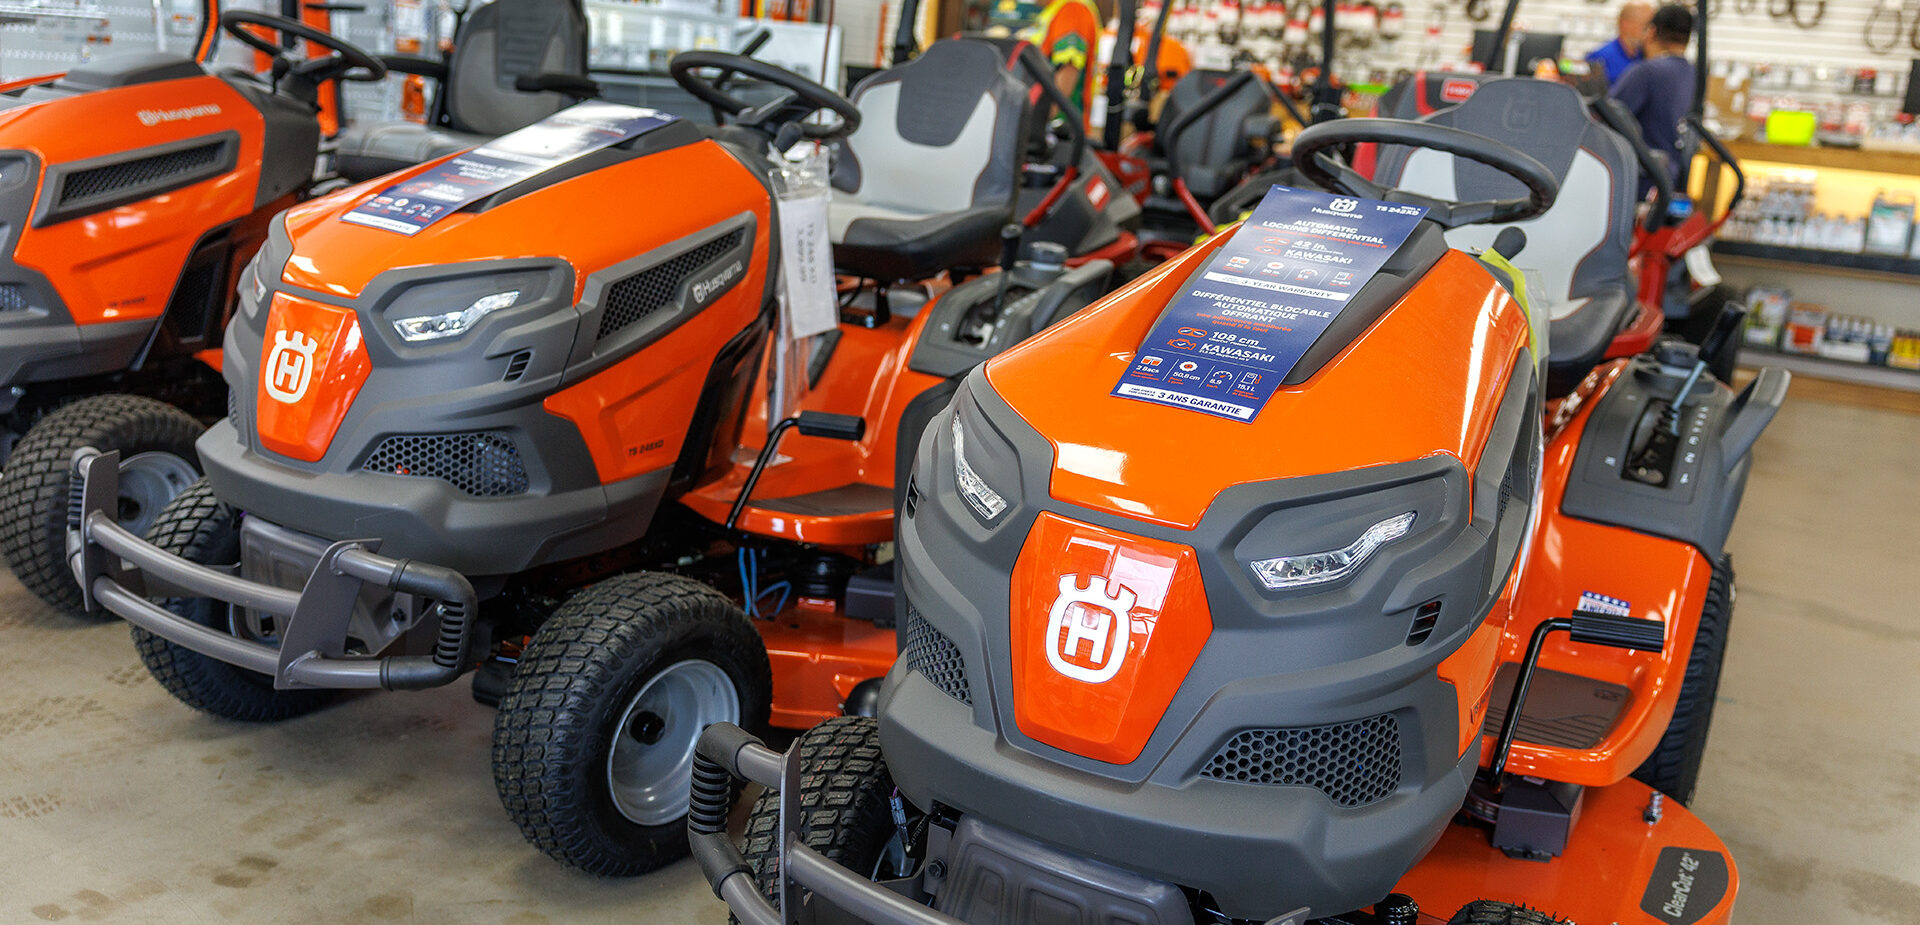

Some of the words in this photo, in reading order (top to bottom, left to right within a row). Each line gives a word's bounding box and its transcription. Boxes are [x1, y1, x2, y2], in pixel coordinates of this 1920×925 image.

[1312, 207, 1363, 219] Husqvarna
[1262, 220, 1309, 234] LOCKING
[1310, 228, 1384, 245] DIFFERENTIAL
[1294, 220, 1358, 234] AUTOMATIC
[1292, 240, 1313, 248] 42
[1284, 248, 1353, 265] KAWASAKI
[702, 260, 743, 297] Husqvarna
[1277, 284, 1332, 298] WARRANTY
[1192, 290, 1267, 309] DIFFÉRENTIEL
[1270, 304, 1331, 318] BLOCABLE
[1212, 302, 1298, 320] AUTOMATIQUE
[1222, 310, 1276, 323] OFFRANT
[1212, 332, 1237, 342] 108
[1238, 336, 1260, 346] cm
[1200, 344, 1275, 362] KAWASAKI
[1172, 371, 1189, 379] 50,8
[1158, 390, 1165, 399] 3
[1167, 392, 1188, 404] ANS
[1190, 398, 1242, 415] GARANTIE
